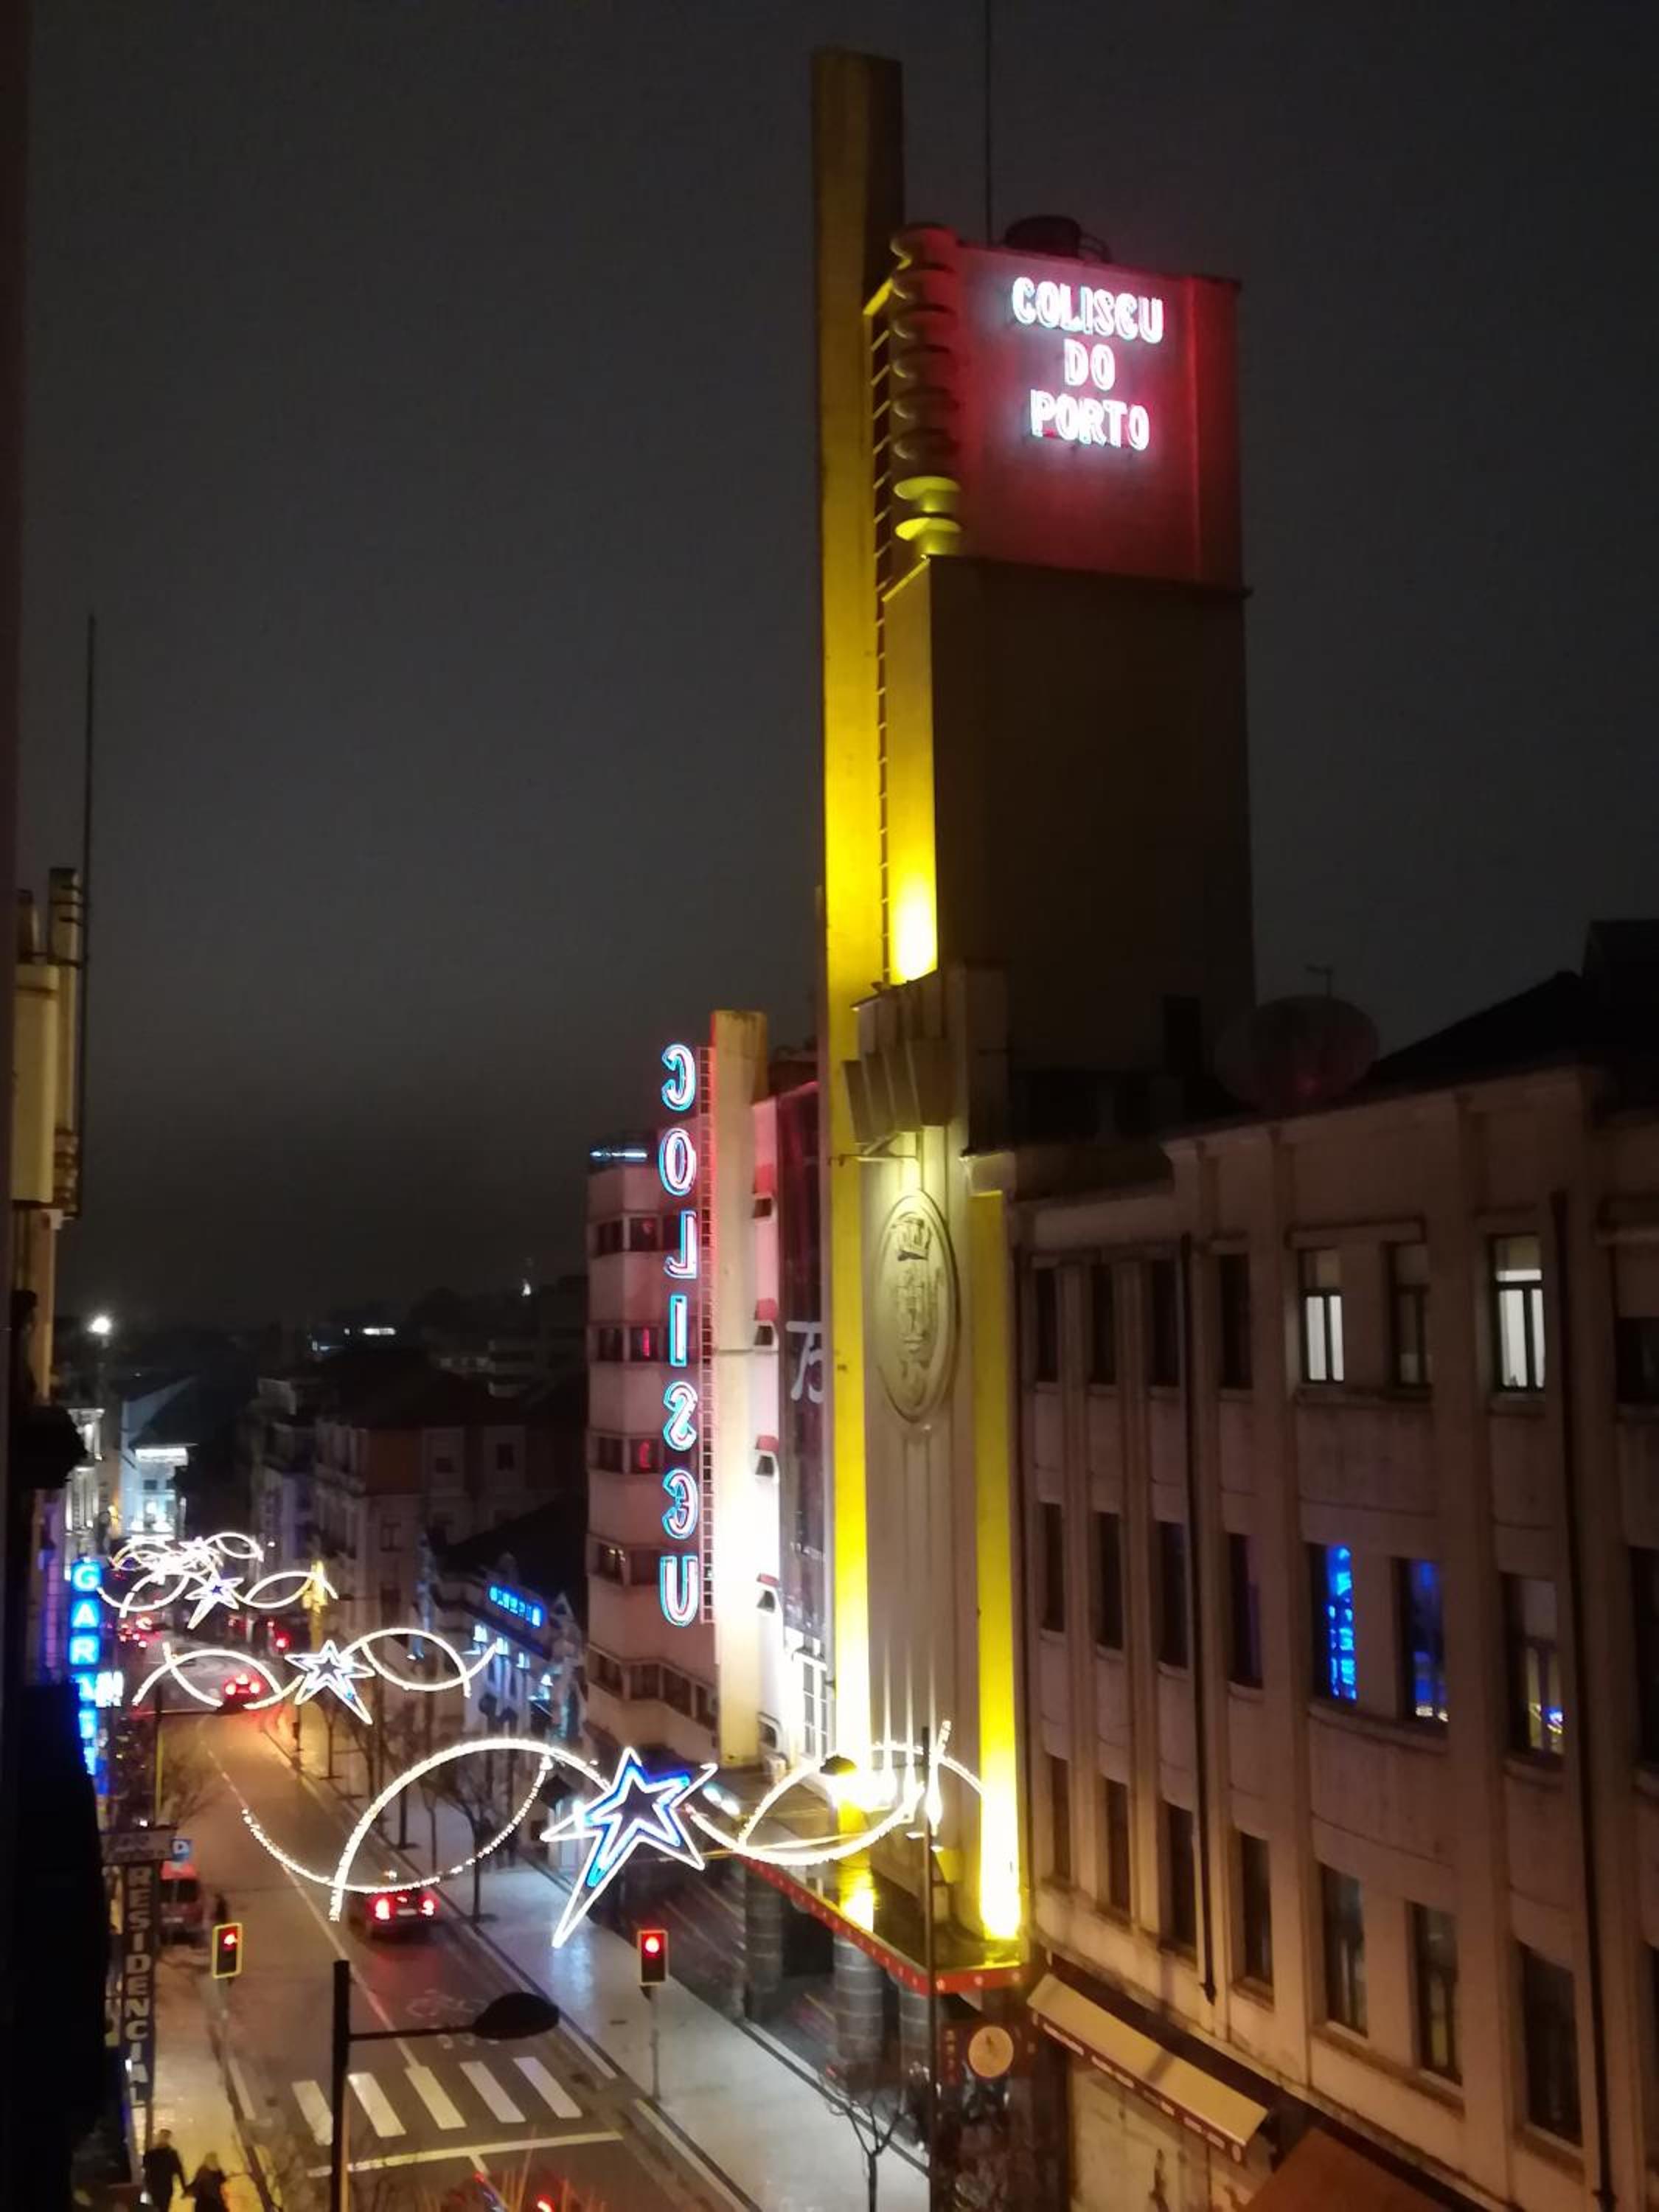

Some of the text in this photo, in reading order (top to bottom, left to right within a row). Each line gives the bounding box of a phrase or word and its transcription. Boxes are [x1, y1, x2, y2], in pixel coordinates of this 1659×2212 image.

[1012, 276, 1164, 344] COLISEU
[1064, 339, 1116, 390] DO
[1030, 389, 1150, 451] PORTO
